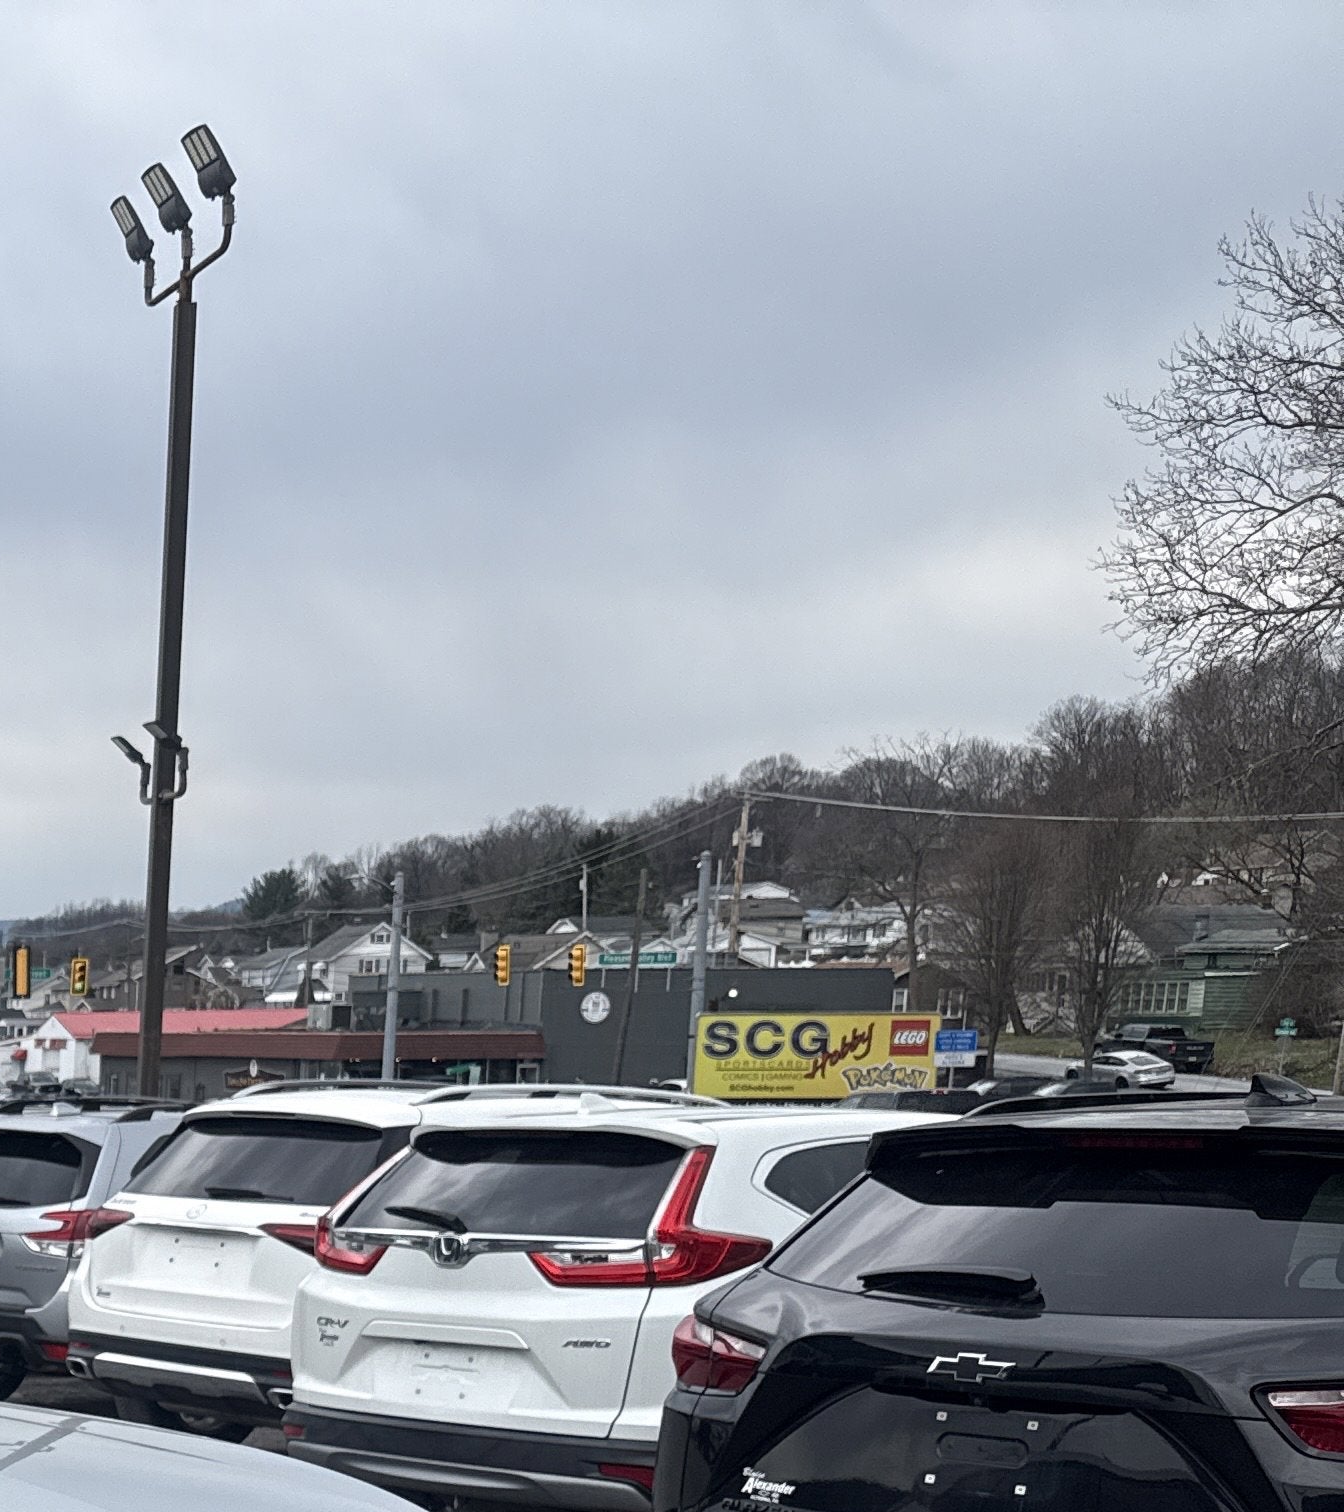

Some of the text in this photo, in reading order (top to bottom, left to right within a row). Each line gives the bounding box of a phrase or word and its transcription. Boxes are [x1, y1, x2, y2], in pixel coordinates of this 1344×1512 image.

[892, 1029, 928, 1046] LEGO
[703, 1020, 875, 1080] SCG Hobby
[741, 1477, 796, 1496] Alexander
